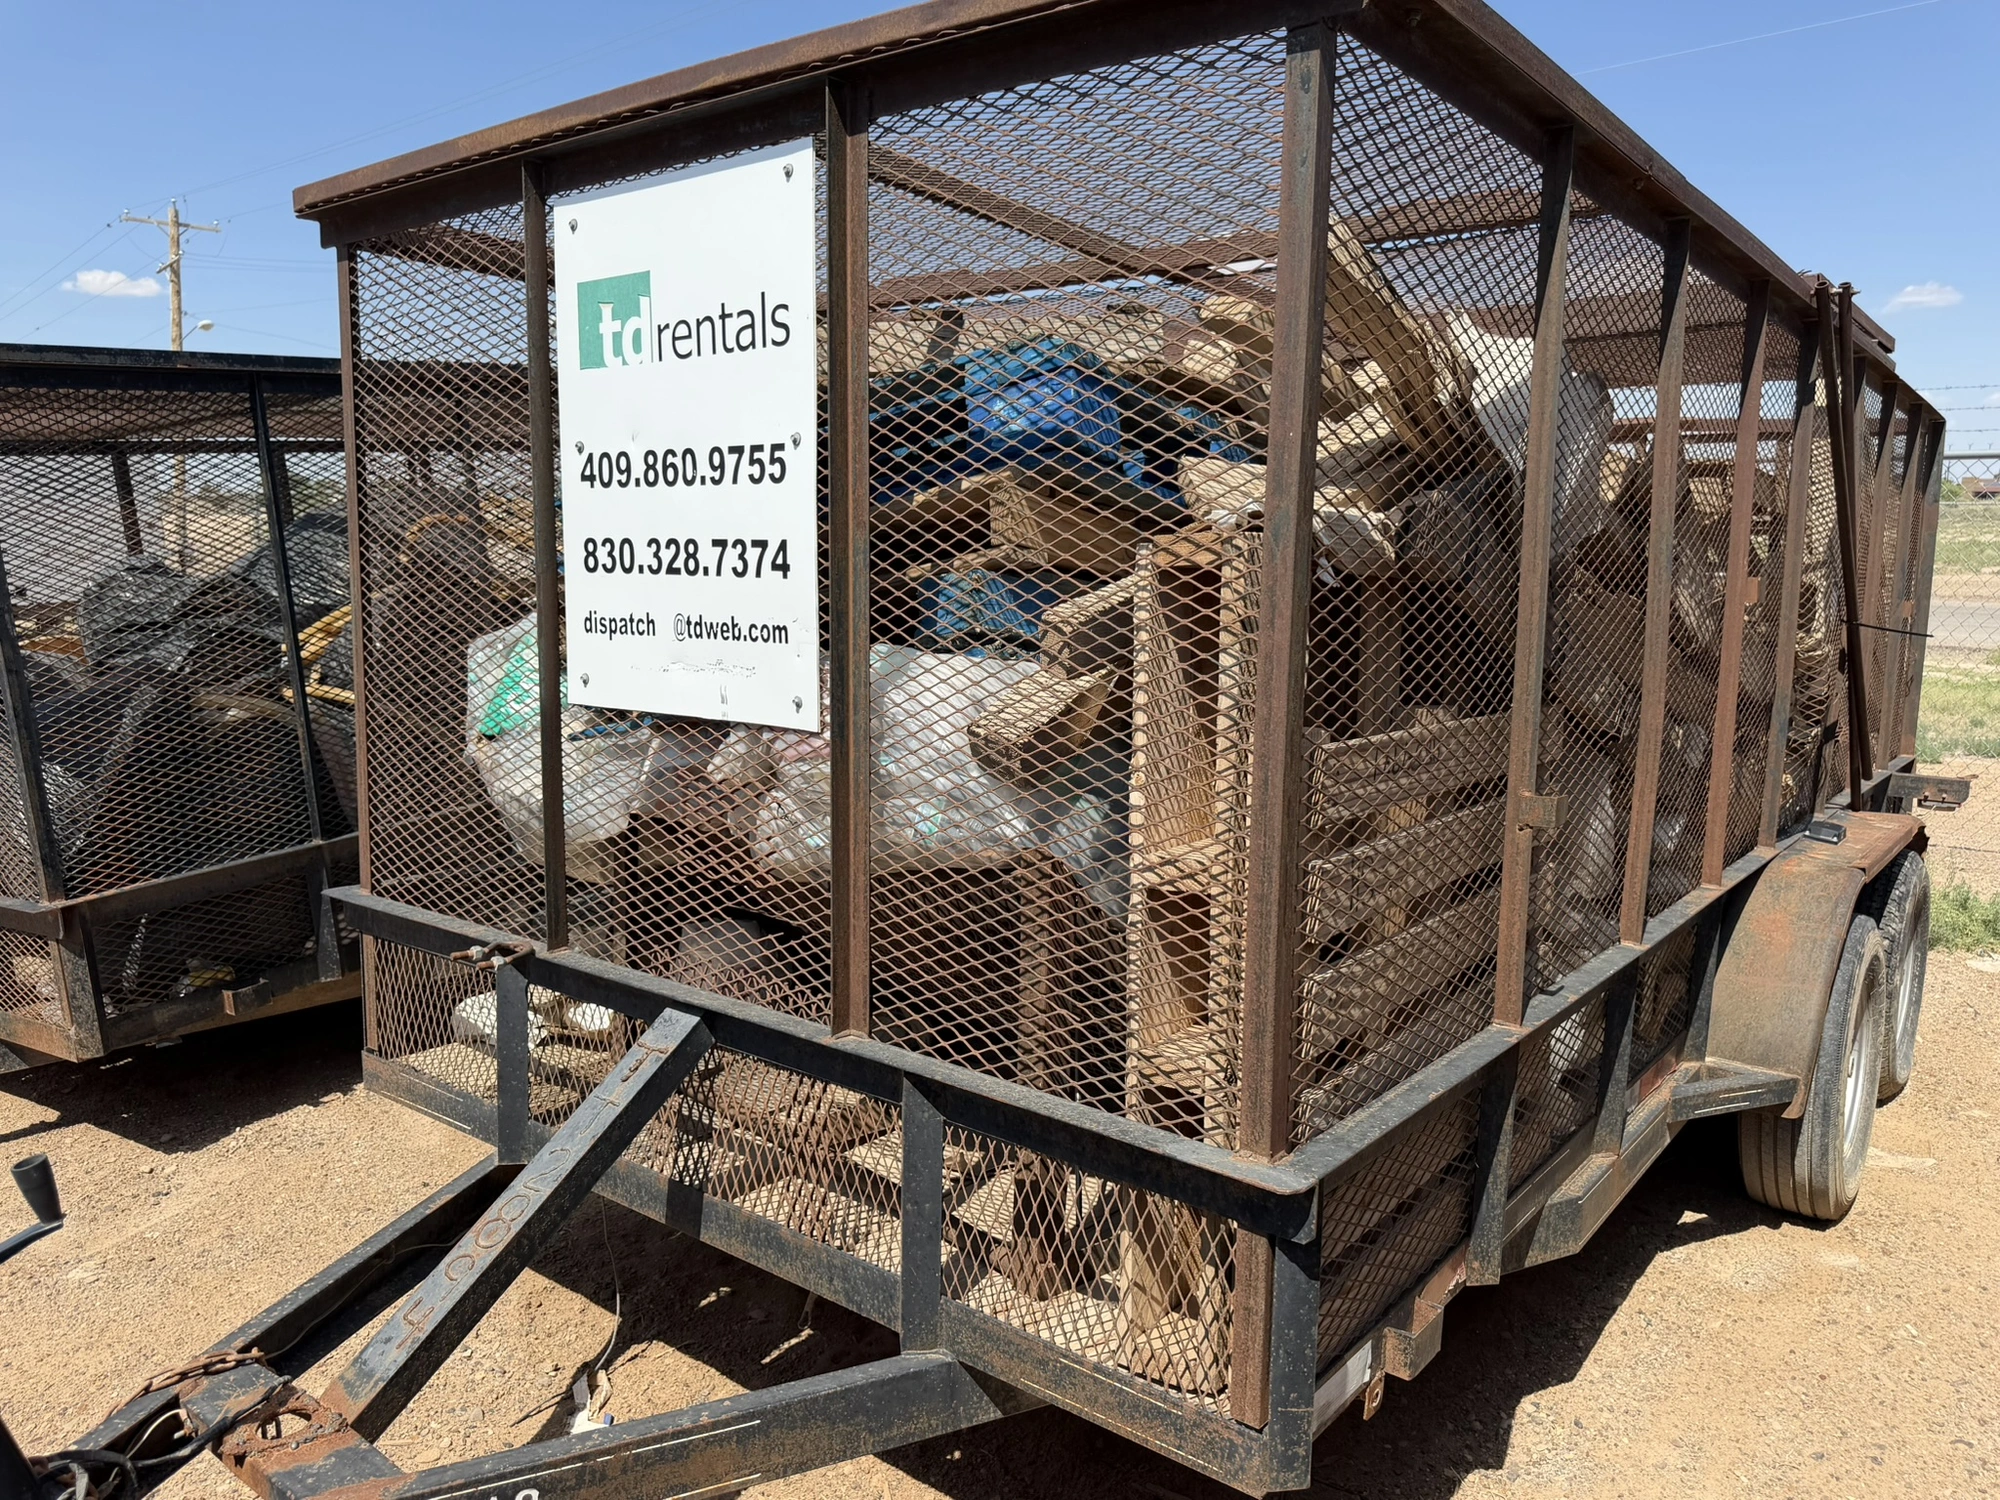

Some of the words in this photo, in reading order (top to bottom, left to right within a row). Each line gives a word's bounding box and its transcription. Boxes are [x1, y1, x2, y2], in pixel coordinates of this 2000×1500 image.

[657, 291, 791, 361] rentals
[580, 443, 787, 488] 409.860.9755
[583, 537, 790, 579] 830.328.7374
[584, 610, 656, 640] dispatch
[673, 613, 789, 644] @tdweb.com
